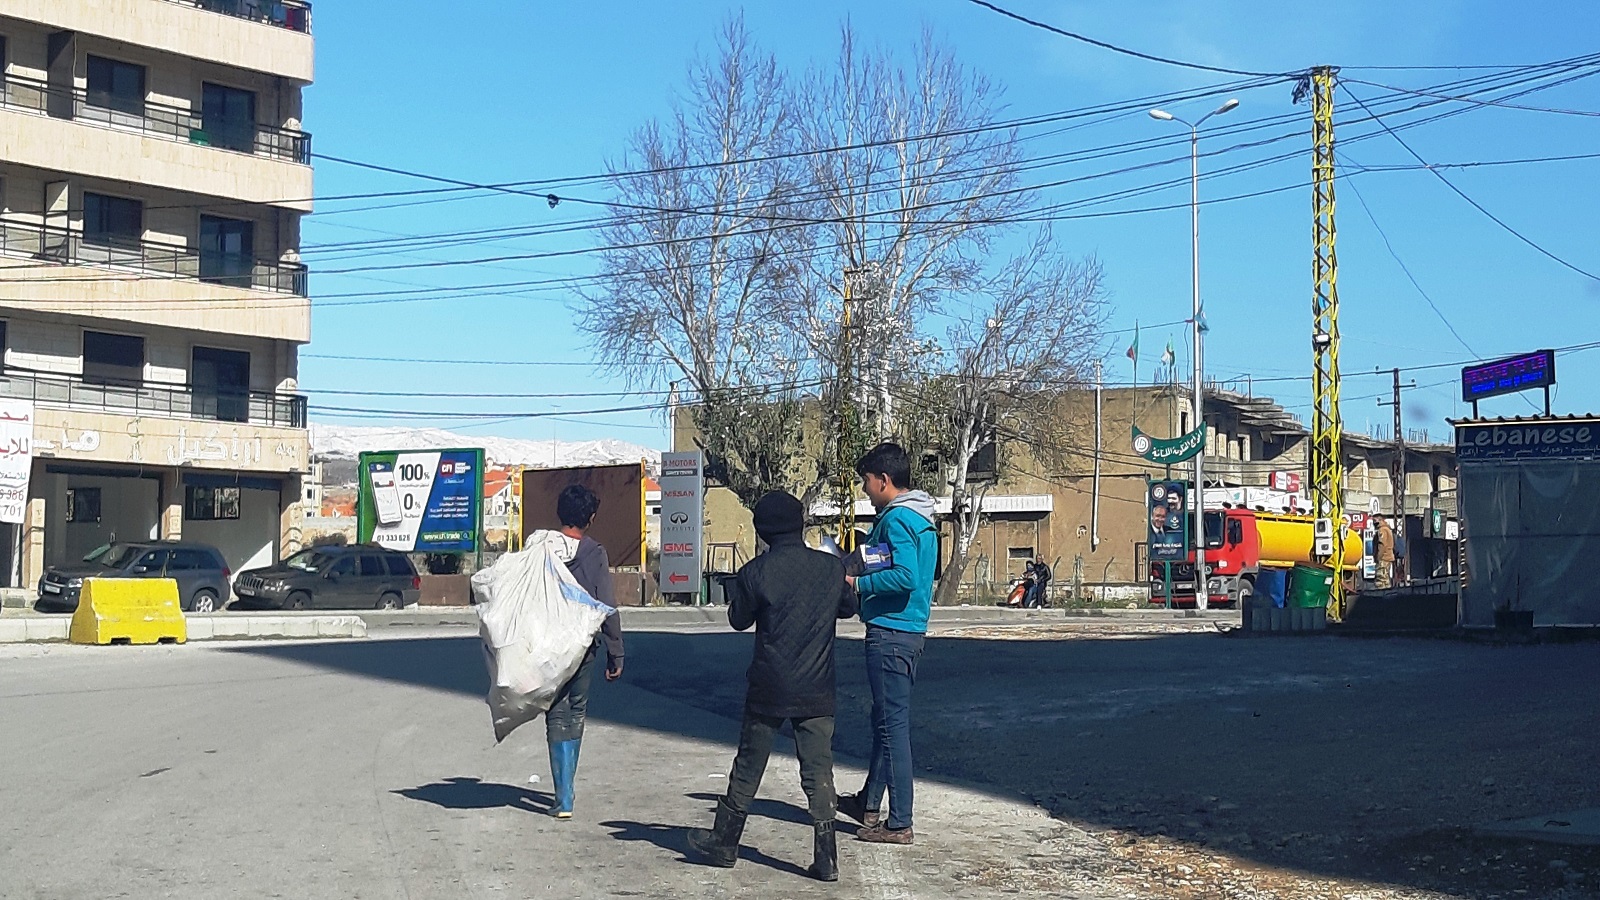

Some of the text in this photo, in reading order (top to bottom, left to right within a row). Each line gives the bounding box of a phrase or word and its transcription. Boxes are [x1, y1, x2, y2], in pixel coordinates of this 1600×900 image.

[1458, 426, 1592, 446] Lebanese
[669, 460, 697, 468] MOTORS
[663, 543, 693, 551] GMC
